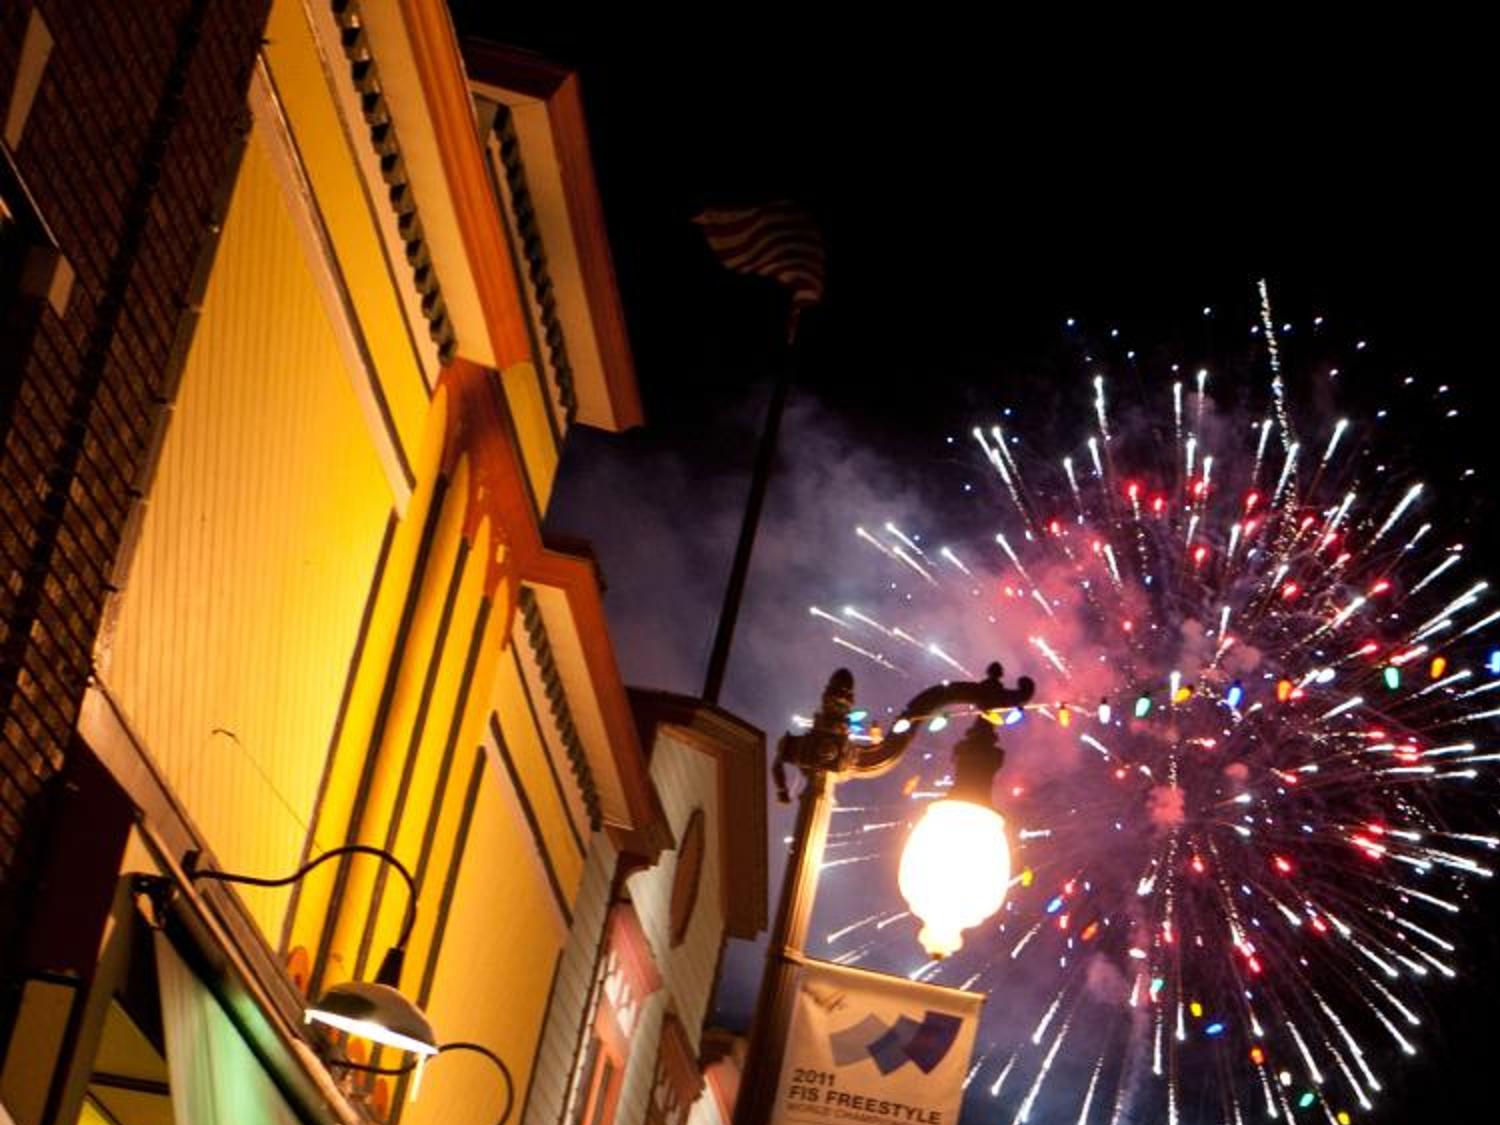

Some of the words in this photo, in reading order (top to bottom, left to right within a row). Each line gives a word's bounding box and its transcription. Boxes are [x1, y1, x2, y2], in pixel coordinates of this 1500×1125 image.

[793, 1068, 836, 1087] 2011
[788, 1084, 819, 1102] FIS
[825, 1089, 943, 1125] FREESTYLE
